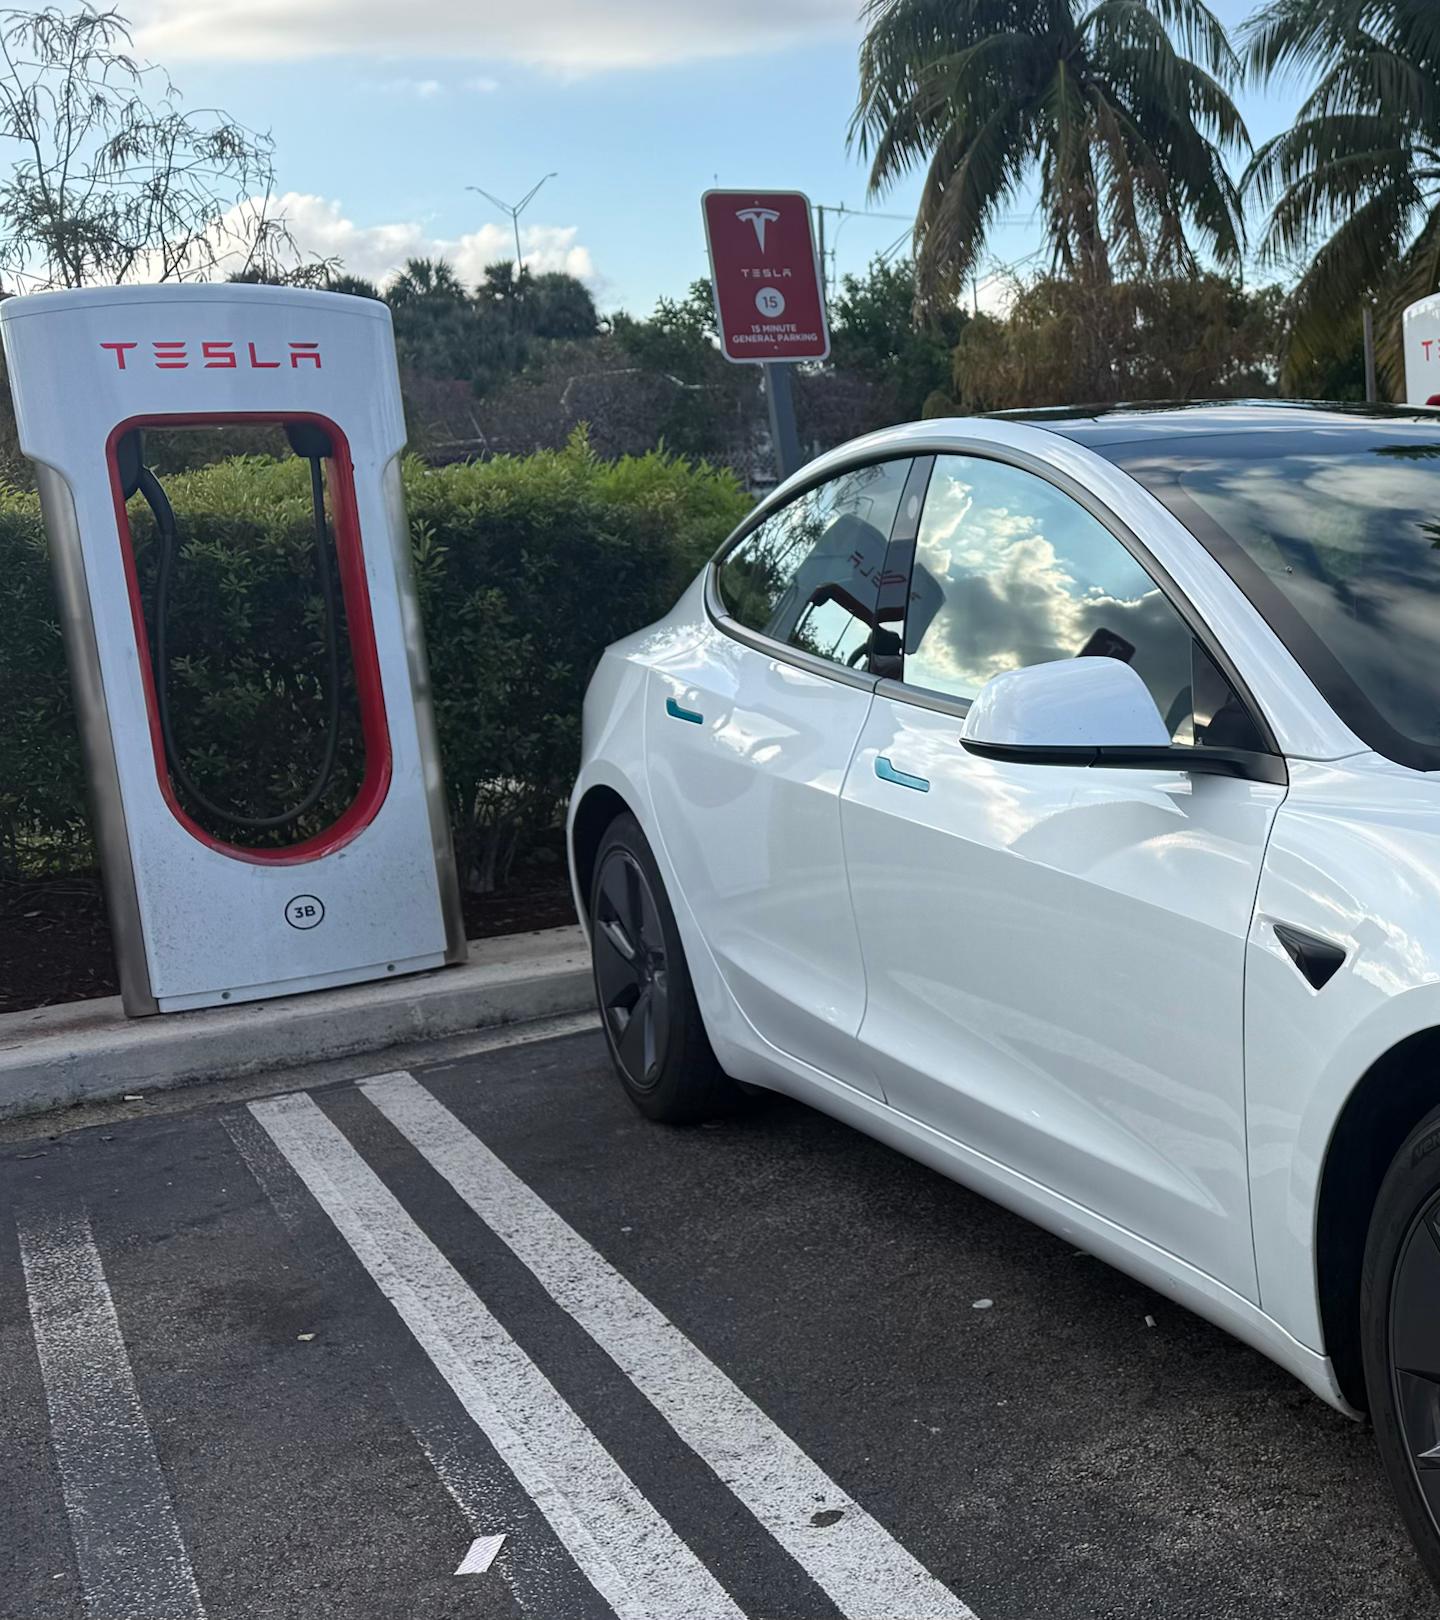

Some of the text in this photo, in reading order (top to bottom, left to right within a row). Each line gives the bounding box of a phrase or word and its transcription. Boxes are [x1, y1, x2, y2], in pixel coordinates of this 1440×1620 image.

[741, 268, 792, 279] TESLA
[762, 296, 777, 309] 15
[751, 323, 797, 333] 15 MINUTE
[732, 332, 818, 344] GENERAL PARKING
[99, 342, 322, 370] TESLA
[294, 905, 316, 919] 3B
